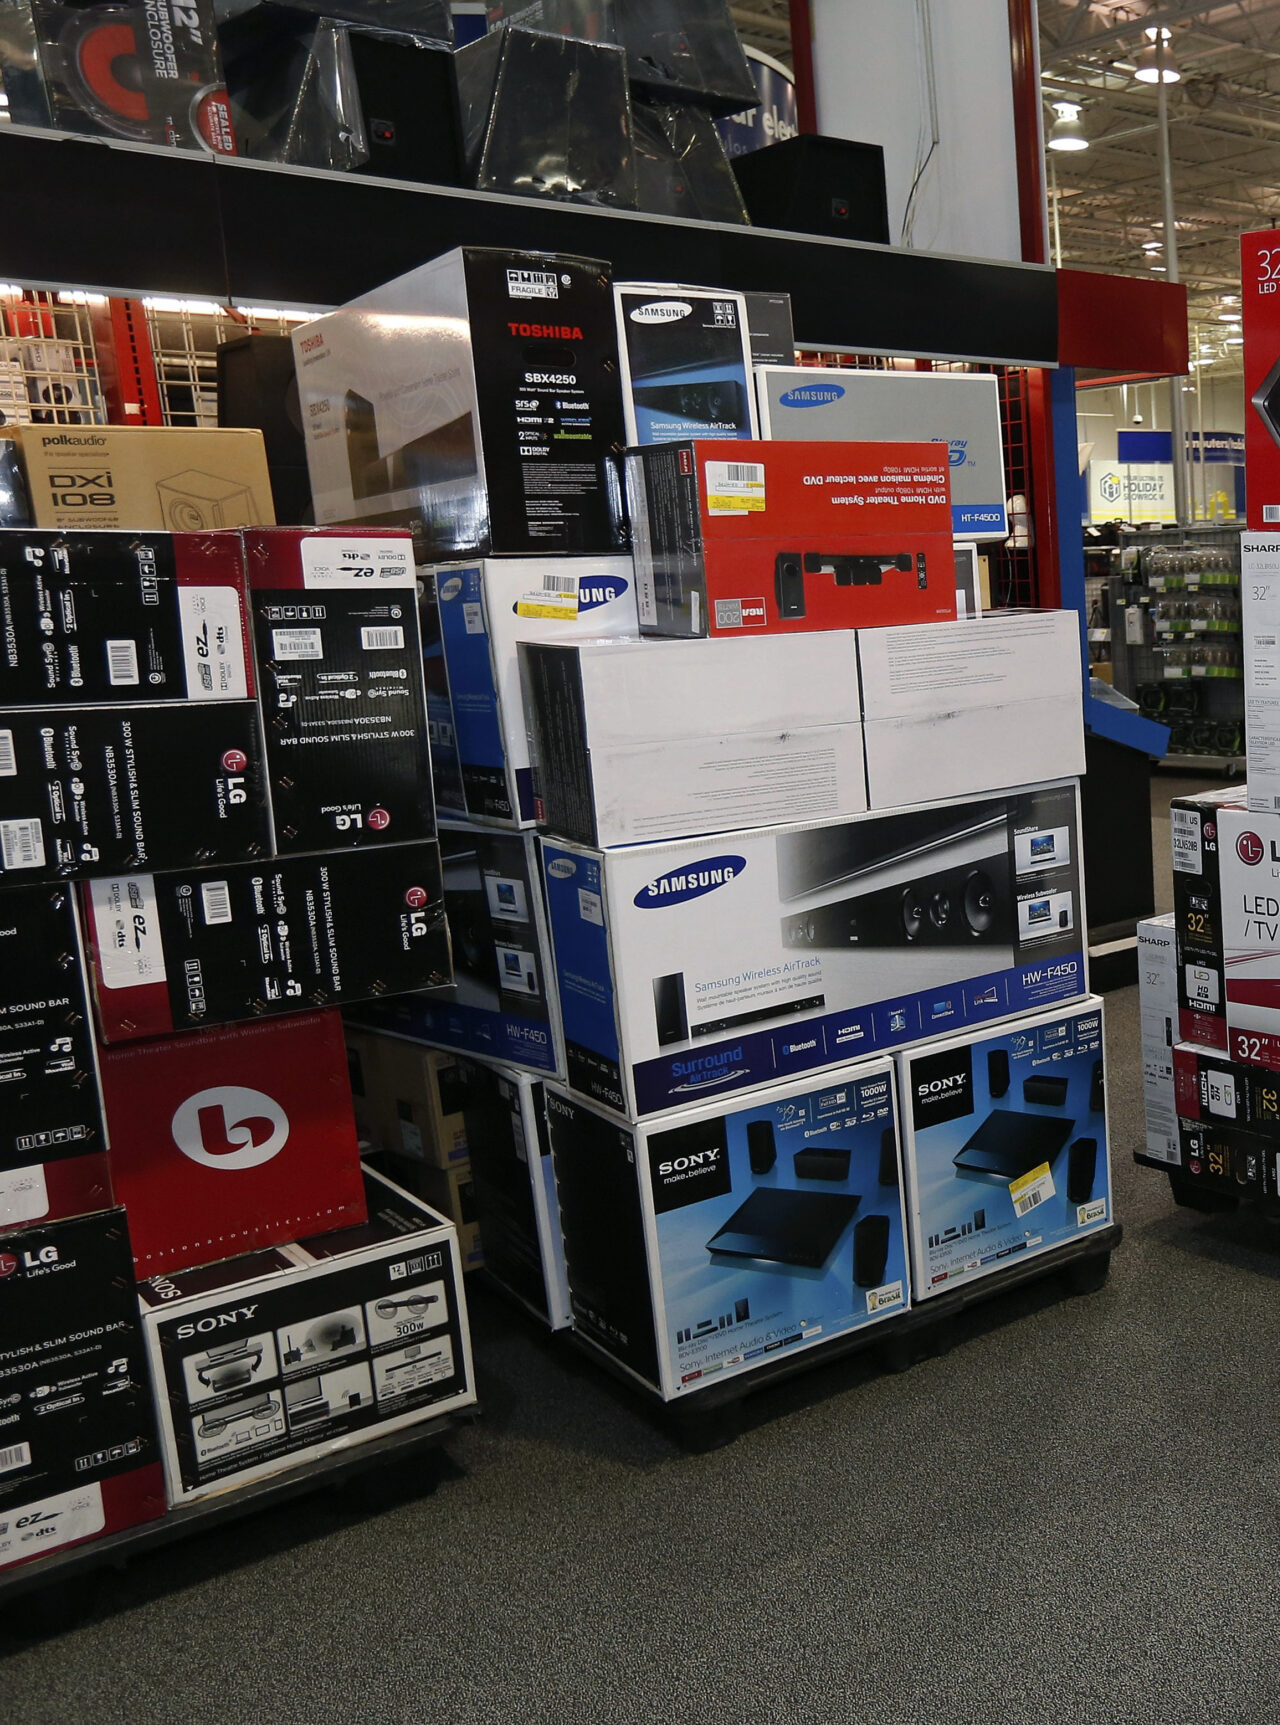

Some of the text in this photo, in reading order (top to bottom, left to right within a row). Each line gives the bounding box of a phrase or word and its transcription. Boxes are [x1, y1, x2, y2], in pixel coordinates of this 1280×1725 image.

[217, 103, 233, 151] SEALED
[511, 286, 543, 295] FRAGILE
[1258, 282, 1277, 294] LED
[638, 307, 685, 318] SAMSUNG
[507, 323, 583, 340] TOSHIBA
[525, 373, 577, 385] SBX4250
[788, 391, 838, 401] SAMSUNG
[651, 421, 737, 431] Samsung Wireless AirTrack
[42, 435, 107, 447] polkaudio
[49, 471, 113, 488] DXi
[803, 475, 876, 485] avec DVD
[1123, 483, 1164, 493] HOLIDAY
[831, 495, 946, 505] DVD Home Theater System
[961, 513, 1001, 522] HT-F4500
[718, 611, 739, 624] 200
[742, 608, 764, 616] RCA
[8, 625, 19, 667] NB3530A
[354, 715, 391, 725] NB3530A
[280, 735, 329, 745] SOUND BAR
[105, 746, 117, 787] NB3530A
[228, 777, 247, 804] LG
[217, 797, 228, 819] Good
[321, 805, 341, 814] Good
[133, 811, 144, 840] SOUND
[335, 813, 362, 830] LG
[1189, 816, 1198, 825] US
[1204, 841, 1216, 851] LG
[647, 867, 735, 896] SAMSUNG
[305, 889, 317, 927] NB3530A
[1243, 894, 1280, 917] LED
[410, 911, 428, 938] LG
[1187, 912, 1209, 932] 32"
[1253, 921, 1279, 941] TV
[1138, 935, 1171, 947] SHARP
[329, 946, 342, 992] SOUND BAR
[695, 956, 822, 993] Samsung Wireless AirTrack
[1022, 961, 1078, 985] HW-F450
[9, 997, 70, 1013] SOUND BAR
[1188, 999, 1216, 1012] HDMI
[506, 1023, 547, 1045] HW-F450
[838, 1024, 861, 1035] HDMI
[1077, 1020, 1099, 1032] 1000W
[790, 1039, 817, 1053] Bluetooth
[1237, 1035, 1269, 1061] 32"
[672, 1046, 743, 1078] Surround
[690, 1066, 729, 1084] AirTrack
[861, 1084, 887, 1098] 1000W
[918, 1073, 967, 1097] SONY
[921, 1088, 963, 1105] make.believe
[550, 1101, 575, 1119] SONY
[1190, 1138, 1199, 1157] LG
[658, 1148, 721, 1176] SONY
[663, 1164, 717, 1185] make.believe
[24, 1246, 59, 1267] LG
[26, 1260, 77, 1278] Life's Good
[176, 1304, 258, 1340] SONY
[43, 1320, 125, 1349] SLIM SOUND BAR
[740, 1337, 764, 1351] Audio
[774, 1325, 797, 1340] Video
